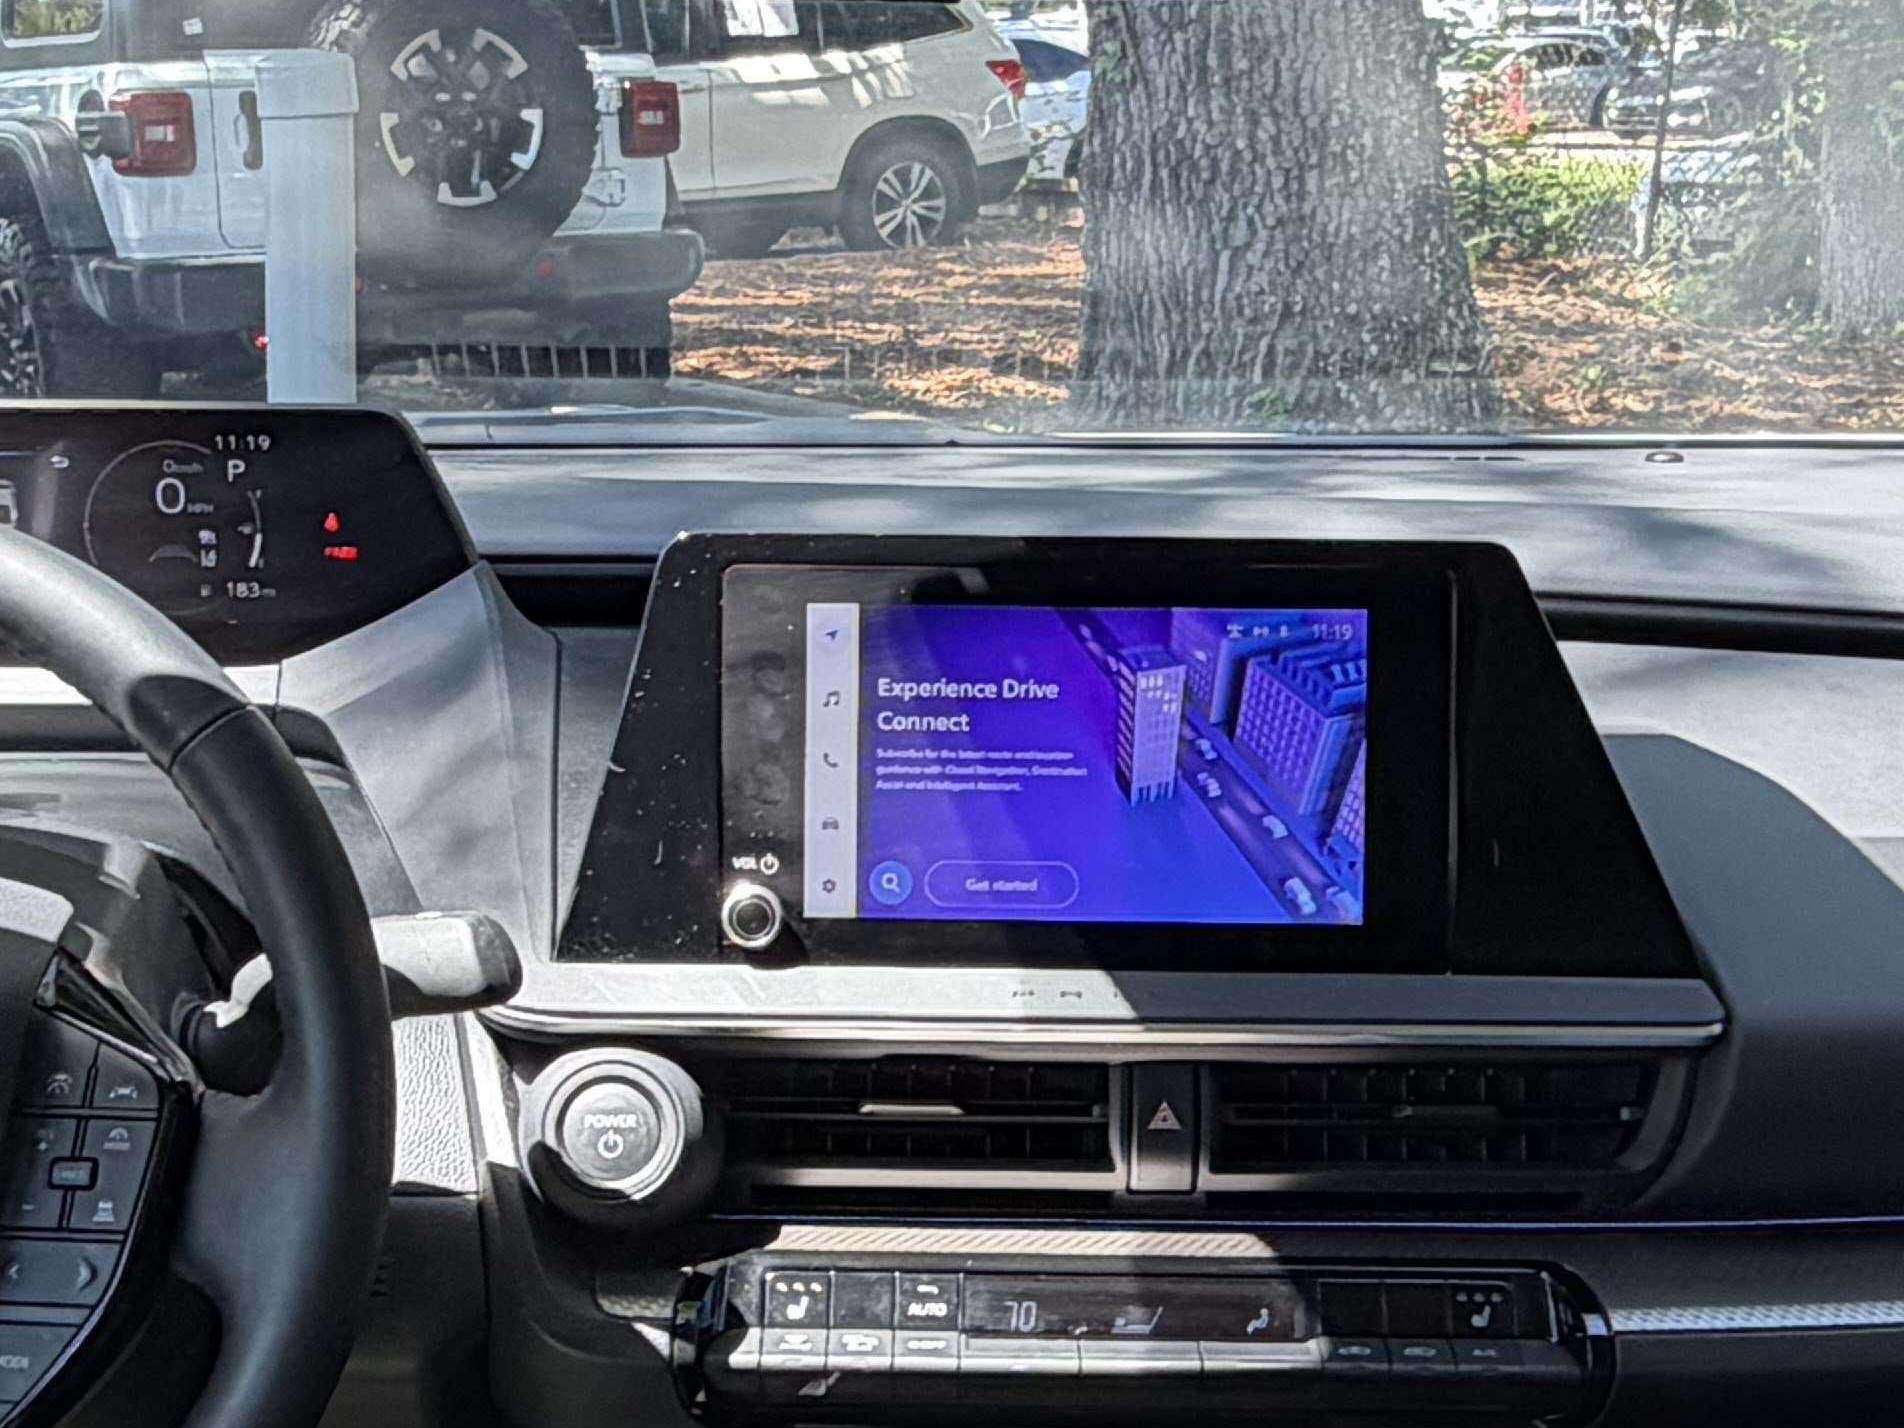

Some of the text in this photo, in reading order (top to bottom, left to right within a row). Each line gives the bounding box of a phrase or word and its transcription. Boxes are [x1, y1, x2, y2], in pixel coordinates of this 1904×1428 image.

[214, 434, 272, 451] 11:19
[226, 458, 246, 483] P
[155, 476, 186, 515] 0
[226, 580, 261, 599] 183
[1312, 623, 1353, 641] 11:19
[877, 677, 1060, 702] Experience Drive
[877, 710, 971, 732] Connect
[731, 856, 758, 871] VOL
[964, 877, 1038, 892] Get started
[584, 1114, 637, 1128] POWER
[907, 1302, 948, 1317] AUTO
[1002, 1300, 1037, 1333] 70
